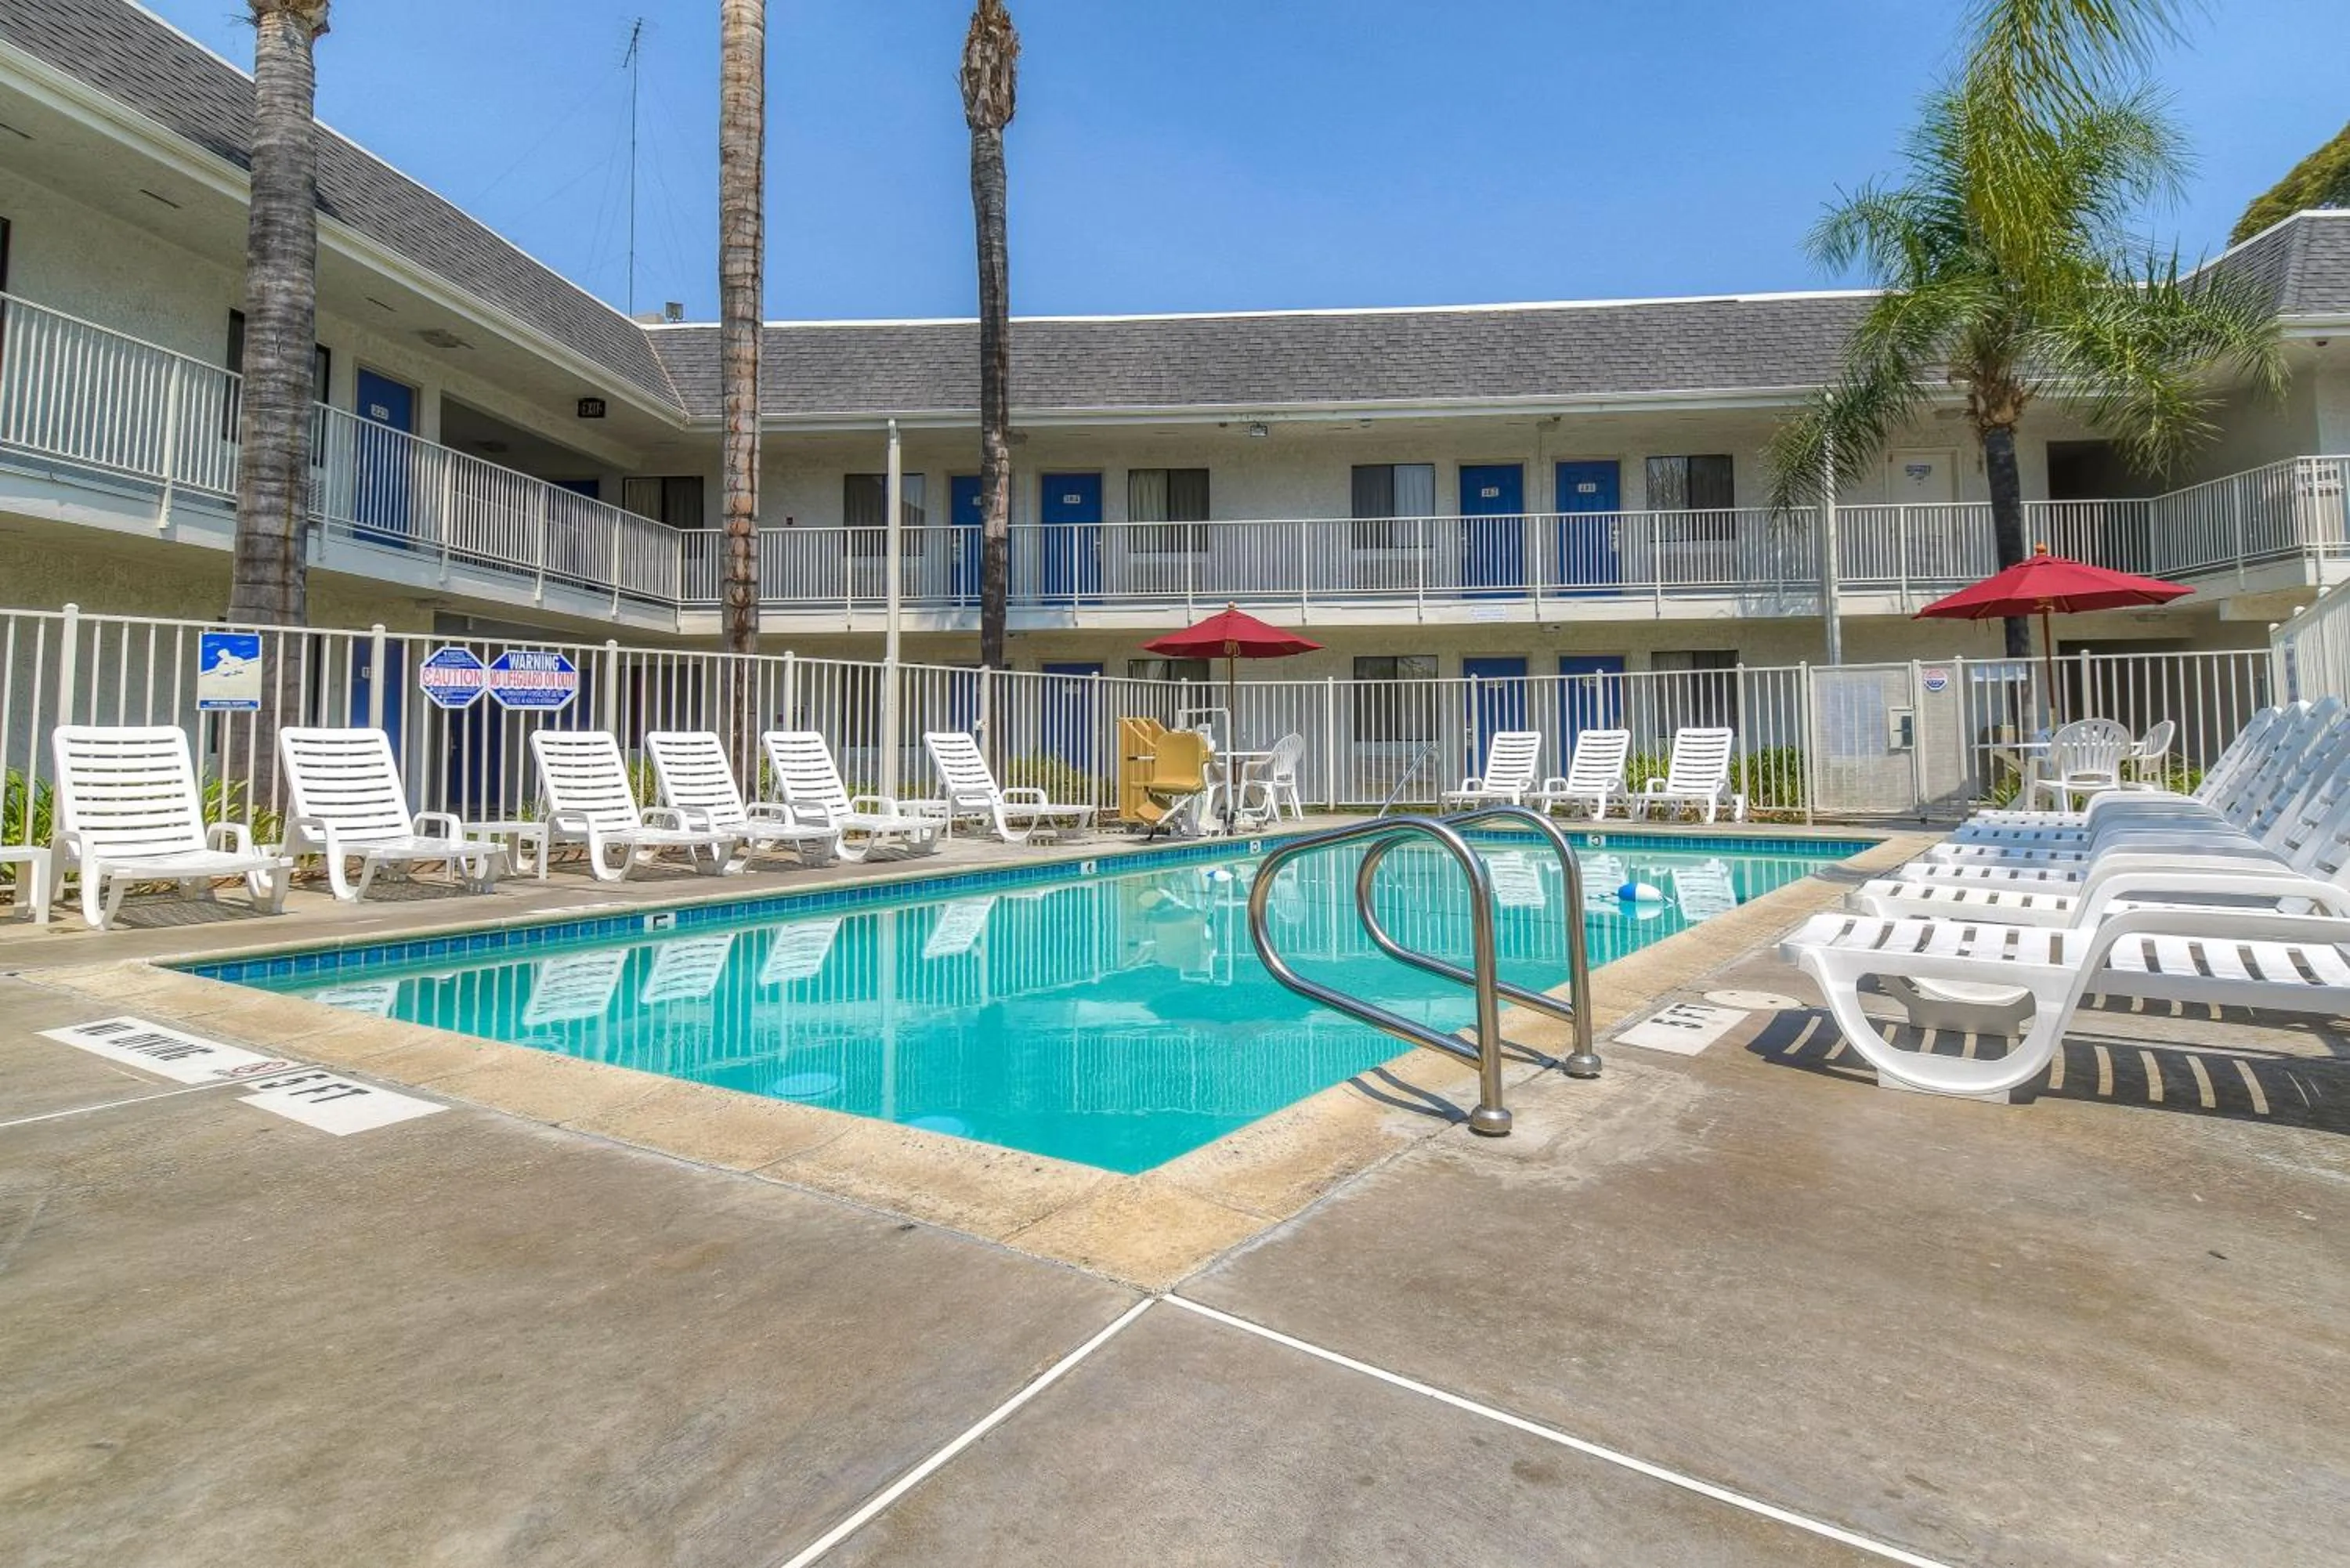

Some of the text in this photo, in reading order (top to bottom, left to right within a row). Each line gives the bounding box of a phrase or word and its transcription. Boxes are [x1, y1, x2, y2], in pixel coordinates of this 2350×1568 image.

[508, 653, 560, 671] WARNING
[423, 668, 481, 685] CAUTION
[490, 670, 500, 687] NO
[502, 670, 543, 687] LIFEGUARD
[545, 671, 555, 687] ON
[288, 1082, 371, 1104] FT
